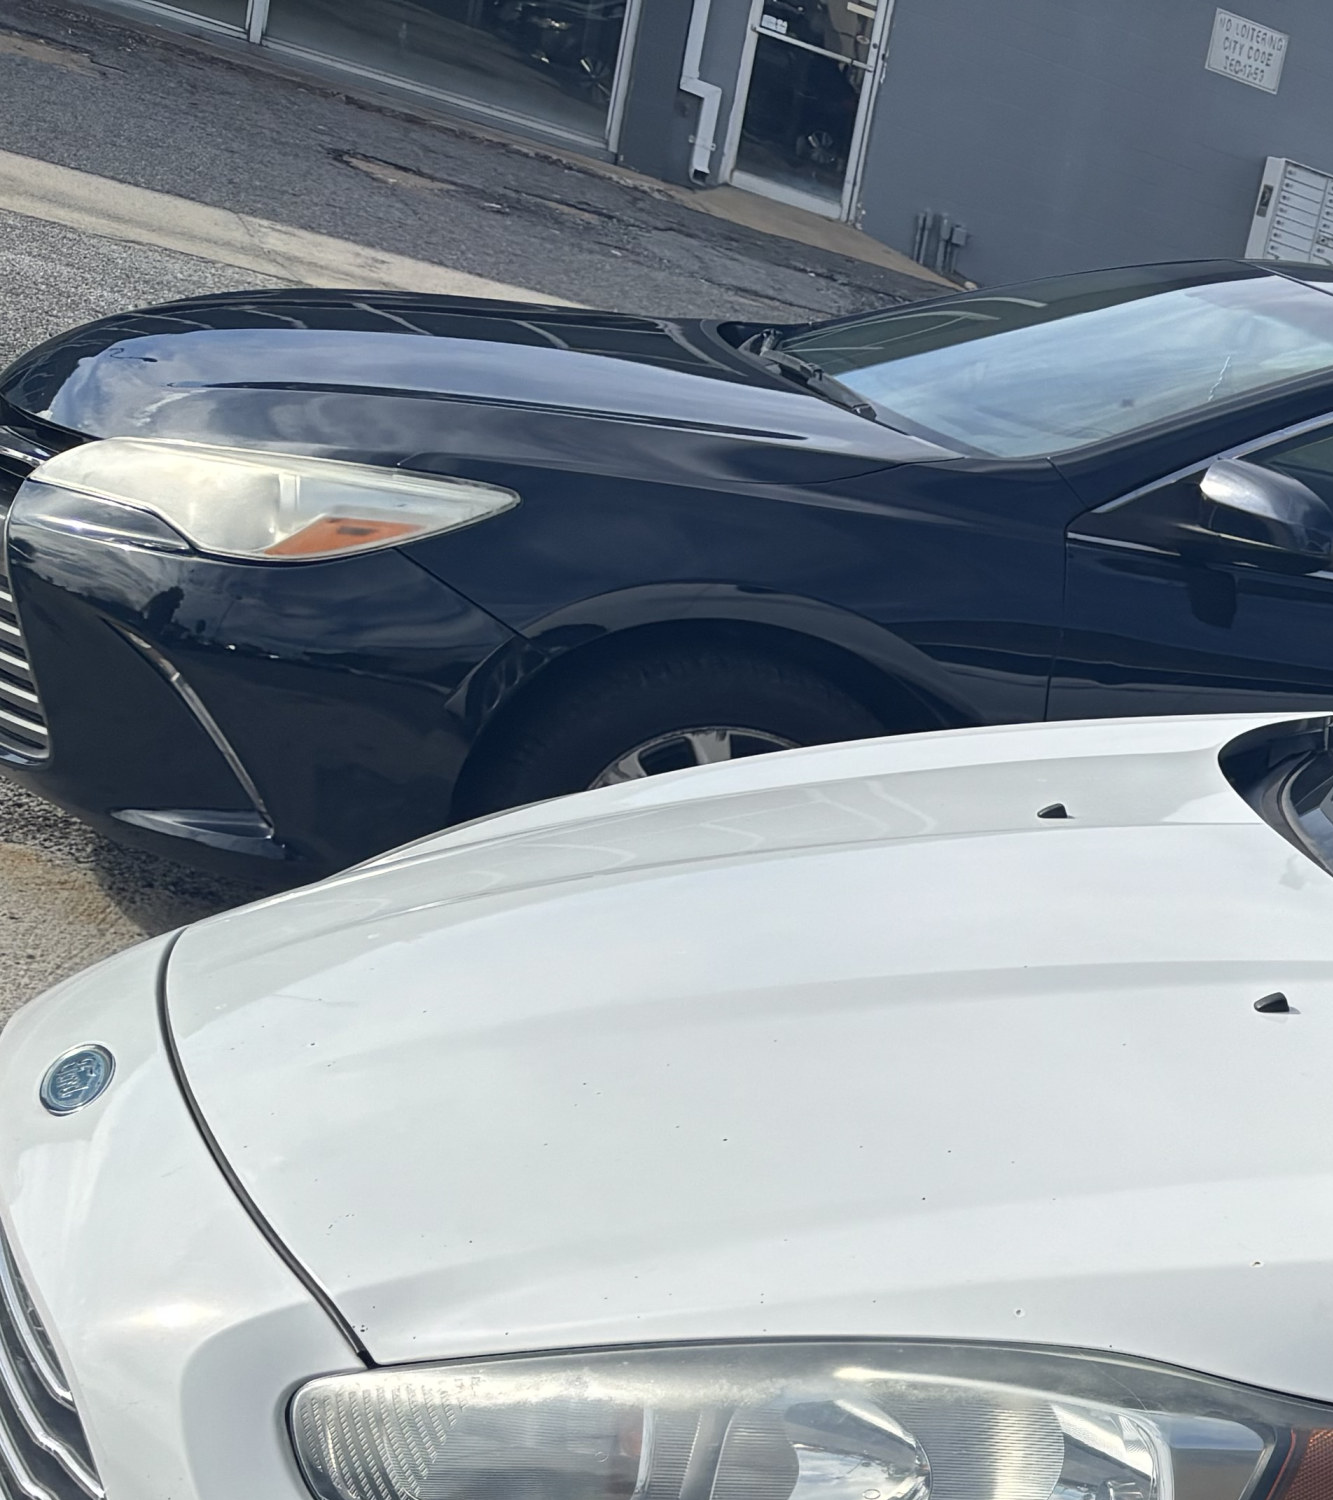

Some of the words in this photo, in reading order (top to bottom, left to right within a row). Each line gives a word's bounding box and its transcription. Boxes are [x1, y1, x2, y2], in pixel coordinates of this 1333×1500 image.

[1220, 17, 1233, 32] NO
[1236, 23, 1284, 52] LOITERING
[1223, 36, 1245, 57] CITY
[1247, 45, 1273, 67] CODE
